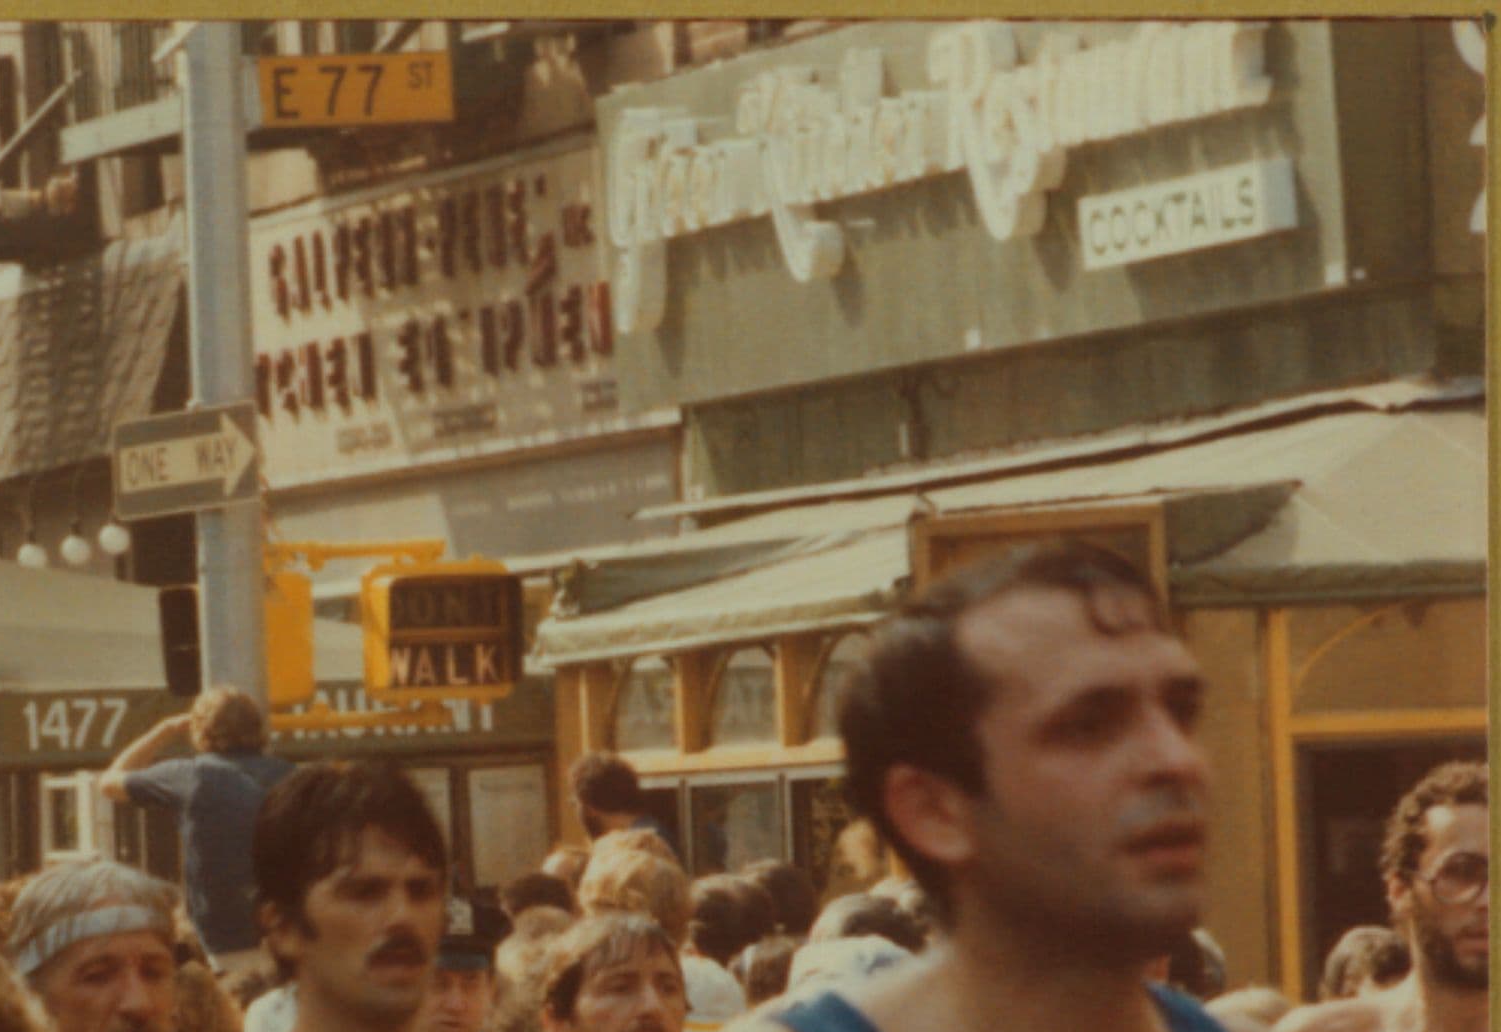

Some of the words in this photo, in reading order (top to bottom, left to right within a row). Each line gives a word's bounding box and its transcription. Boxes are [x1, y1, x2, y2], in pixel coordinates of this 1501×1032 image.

[273, 66, 301, 119] E
[318, 63, 385, 117] 77
[408, 60, 435, 90] ST
[1090, 176, 1254, 257] COCKTAILS
[126, 446, 170, 487] ONE
[195, 435, 241, 471] WAY
[390, 643, 501, 686] WALK
[22, 697, 129, 752] 1477
